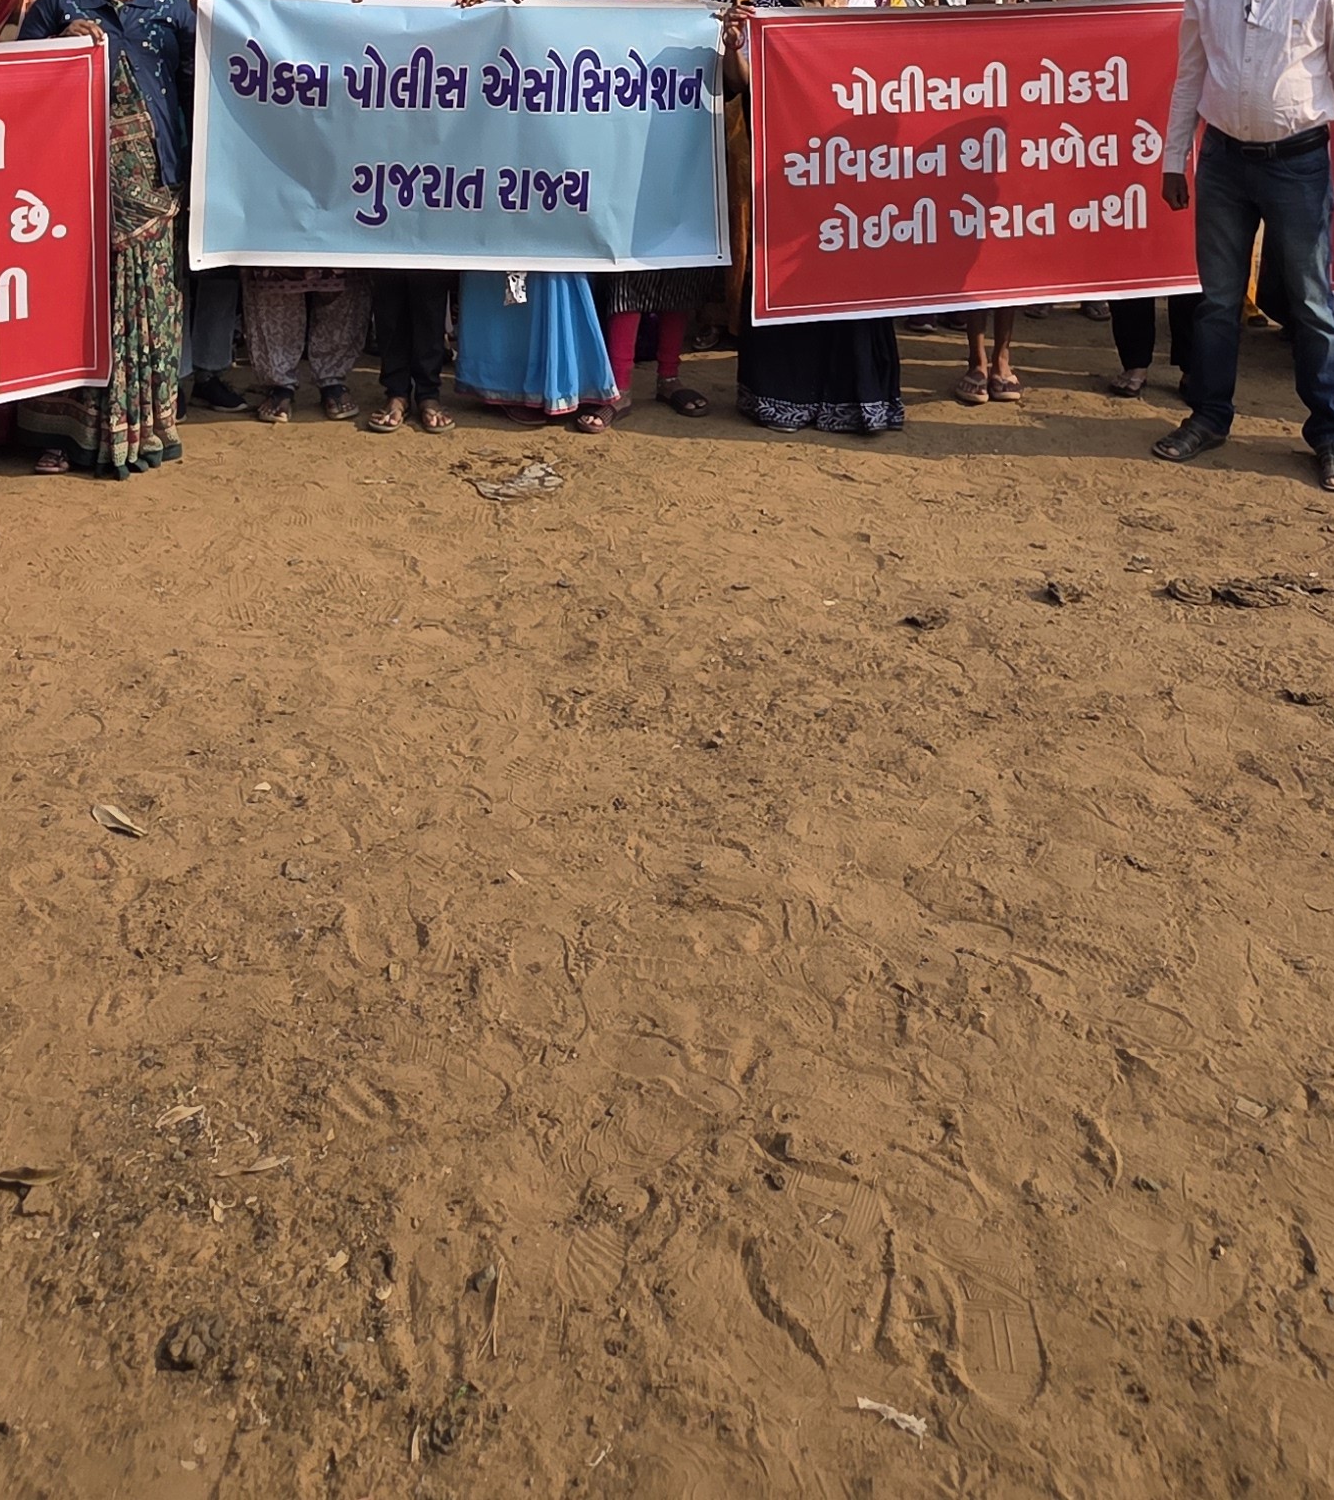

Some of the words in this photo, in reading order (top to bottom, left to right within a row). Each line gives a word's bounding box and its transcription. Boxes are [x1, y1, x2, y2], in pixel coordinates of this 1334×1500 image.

[344, 45, 467, 109] પોલીસ
[480, 46, 704, 114] એસોસિએશન
[832, 62, 1007, 115] પોલીસની
[1020, 56, 1128, 105] નોકરી
[784, 136, 946, 186] સંવિધાન
[960, 127, 1007, 173] થી
[1021, 122, 1118, 170] મળેલ
[10, 189, 67, 243] છે.
[352, 164, 484, 226] ગુજરાત
[498, 169, 589, 212] રાજ્ય
[818, 198, 937, 251] કોઈની
[950, 194, 1055, 239] ખેરાત
[1068, 184, 1147, 232] નથી
